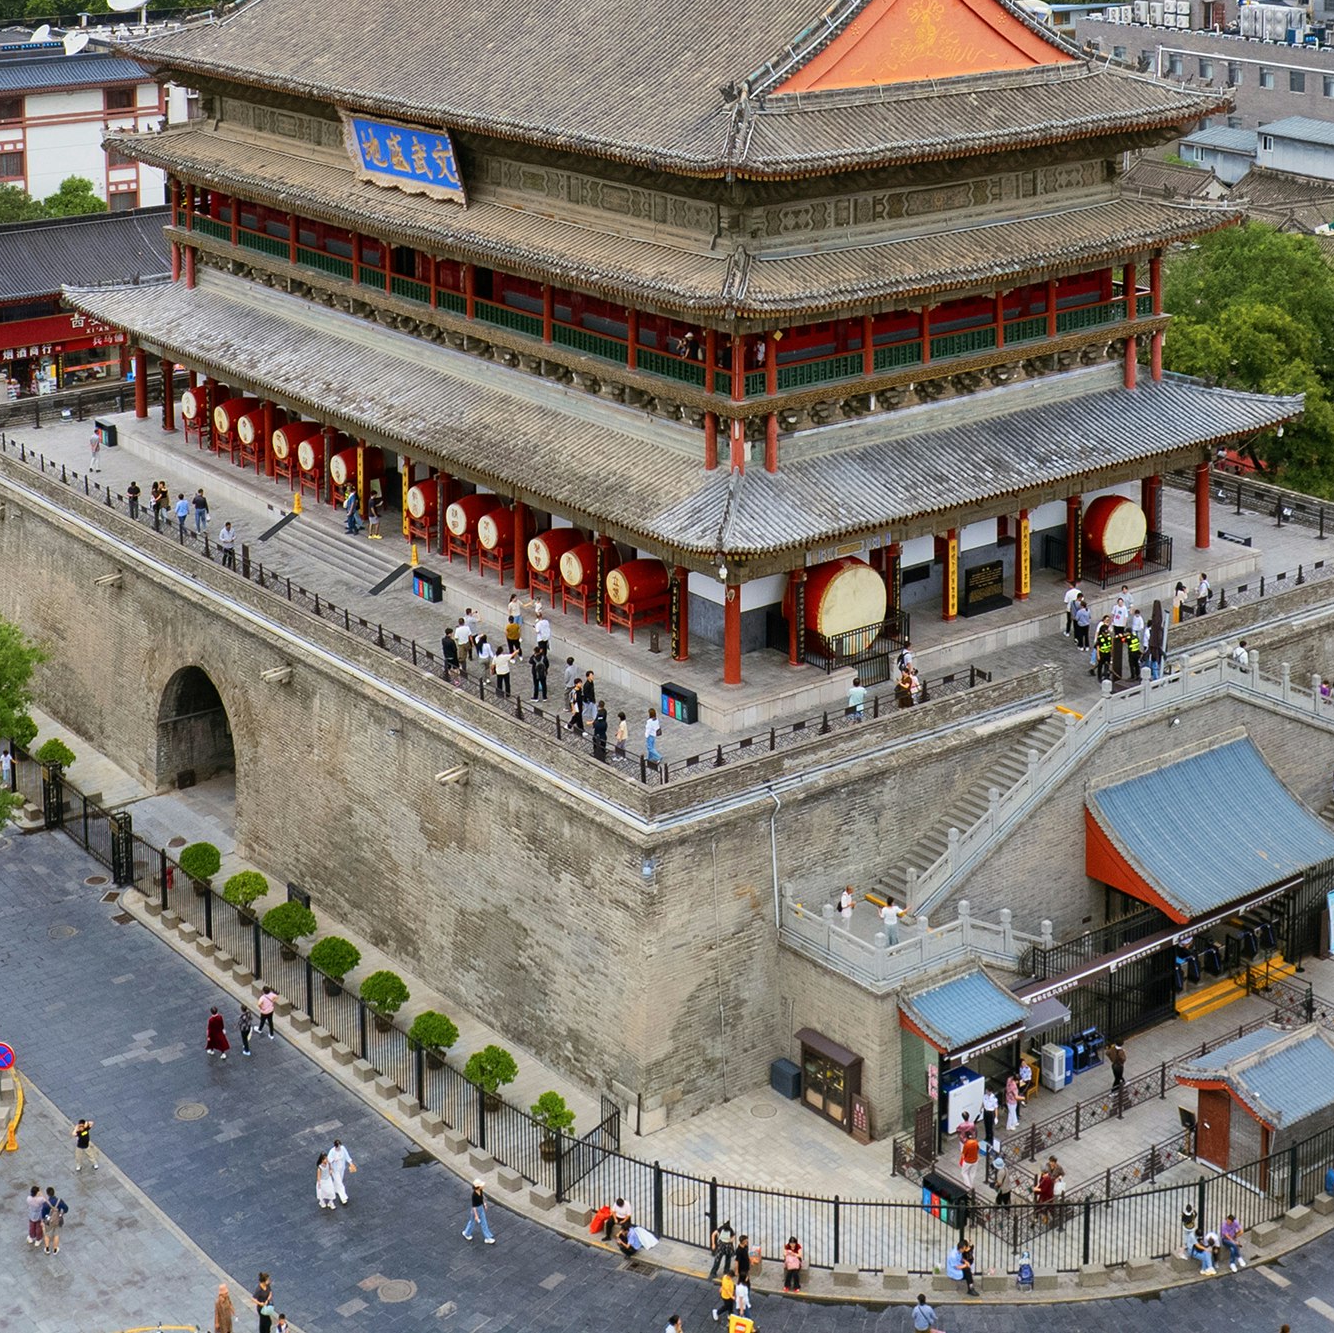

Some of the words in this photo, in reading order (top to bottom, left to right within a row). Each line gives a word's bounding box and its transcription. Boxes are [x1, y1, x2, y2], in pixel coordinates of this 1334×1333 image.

[85, 325, 110, 334] XI'AN
[2, 344, 53, 361] 烟酒商行
